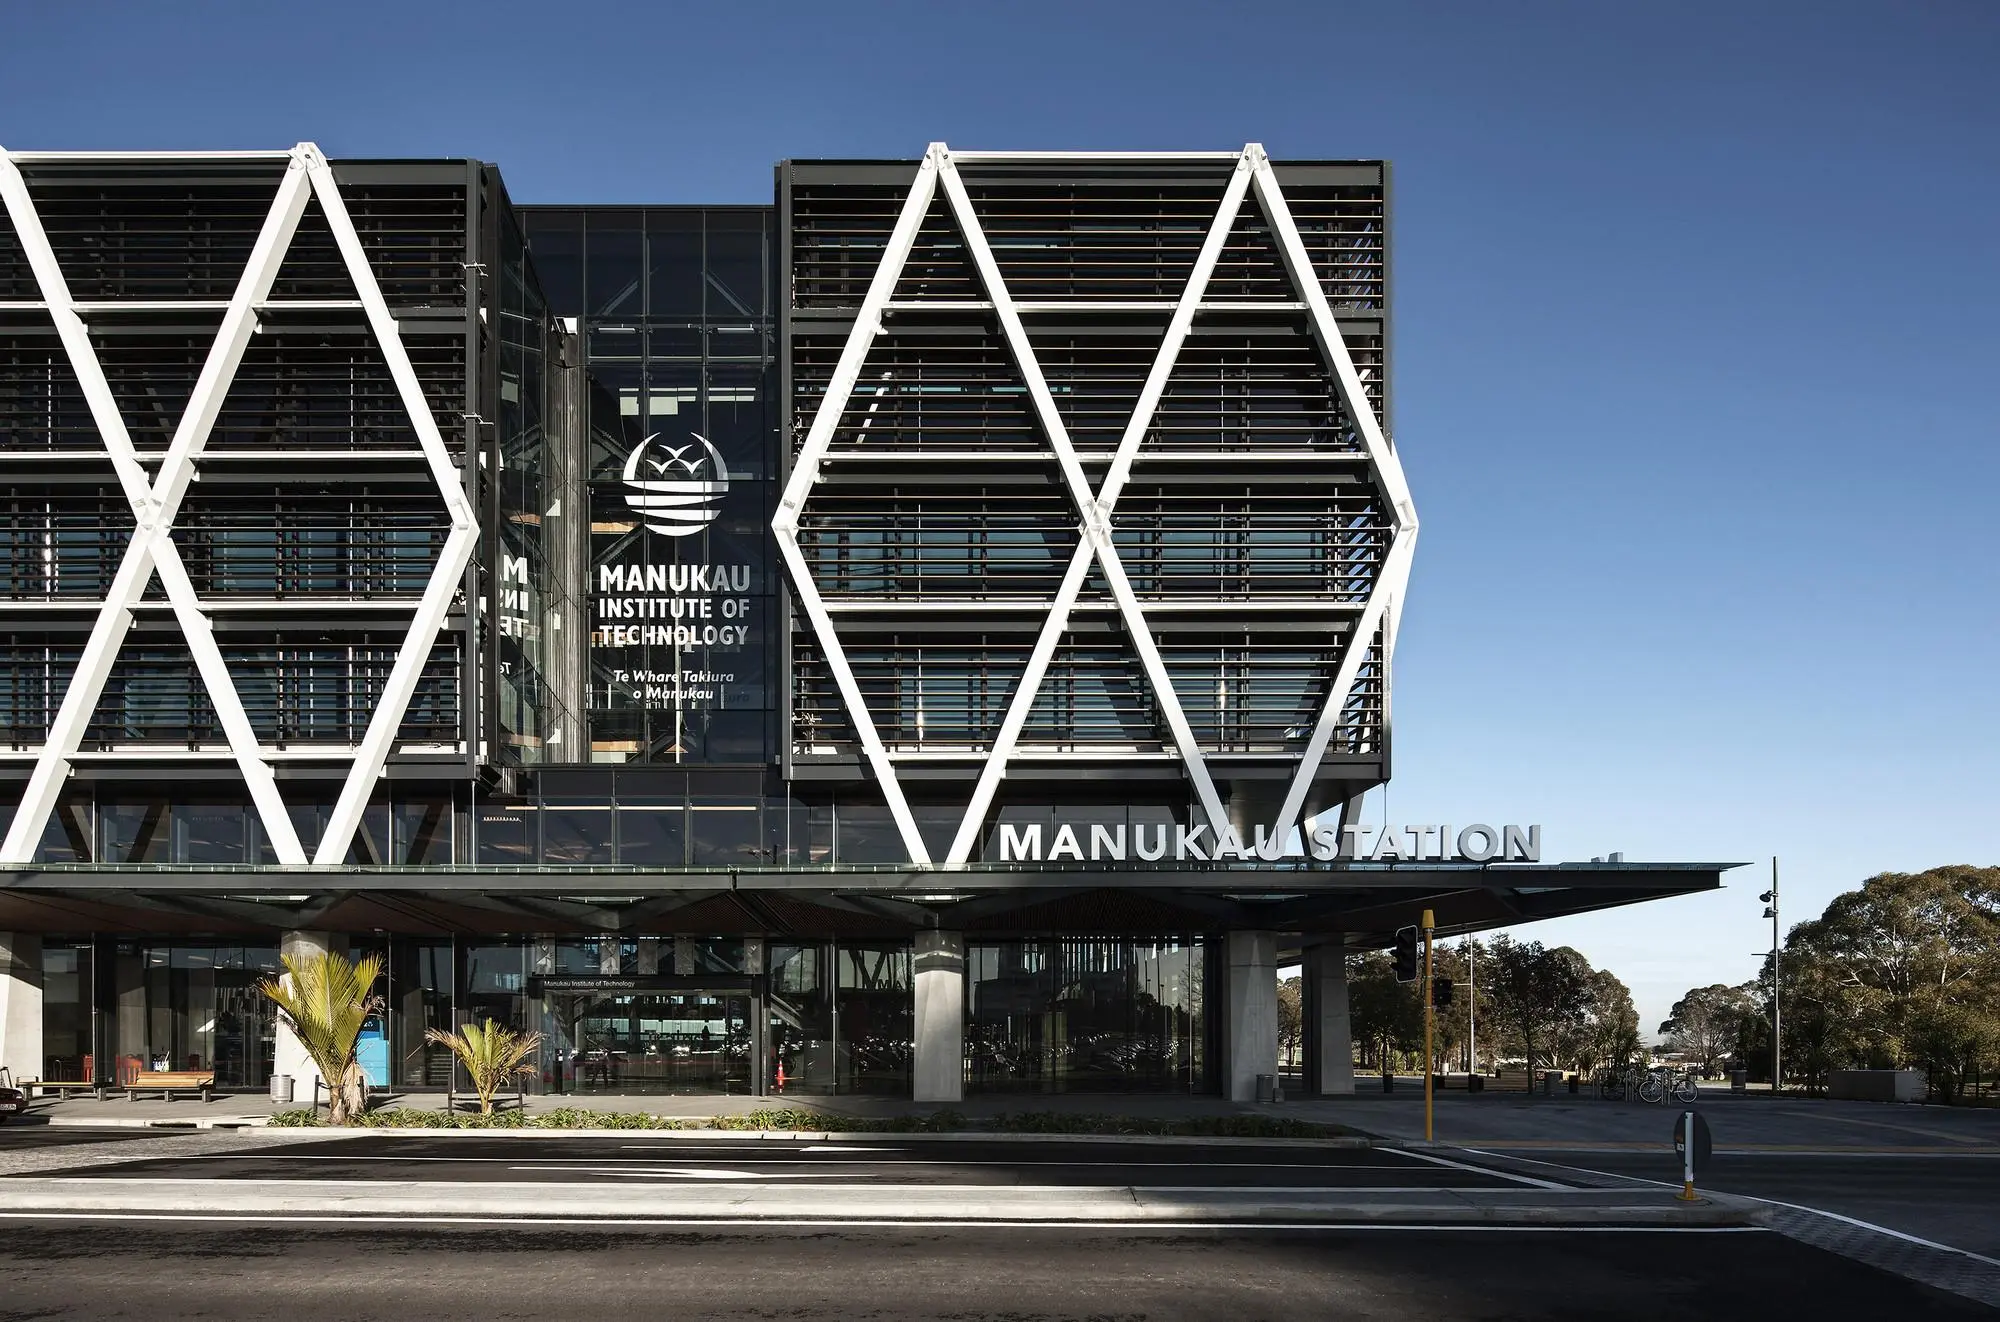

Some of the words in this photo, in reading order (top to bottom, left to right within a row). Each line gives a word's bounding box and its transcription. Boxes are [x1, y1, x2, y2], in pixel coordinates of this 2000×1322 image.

[600, 564, 750, 592] MANUKAU
[600, 598, 712, 619] INSTITUTE
[722, 598, 750, 618] OF
[600, 625, 749, 646] TECHNOLOGY
[614, 670, 629, 683] Te
[633, 670, 678, 683] Whare
[681, 670, 734, 683] Takiura
[633, 688, 642, 699] o
[647, 687, 714, 700] Manukau
[999, 823, 1292, 861] MANUKAU
[1312, 822, 1541, 862] STATION
[603, 980, 635, 988] Technology
